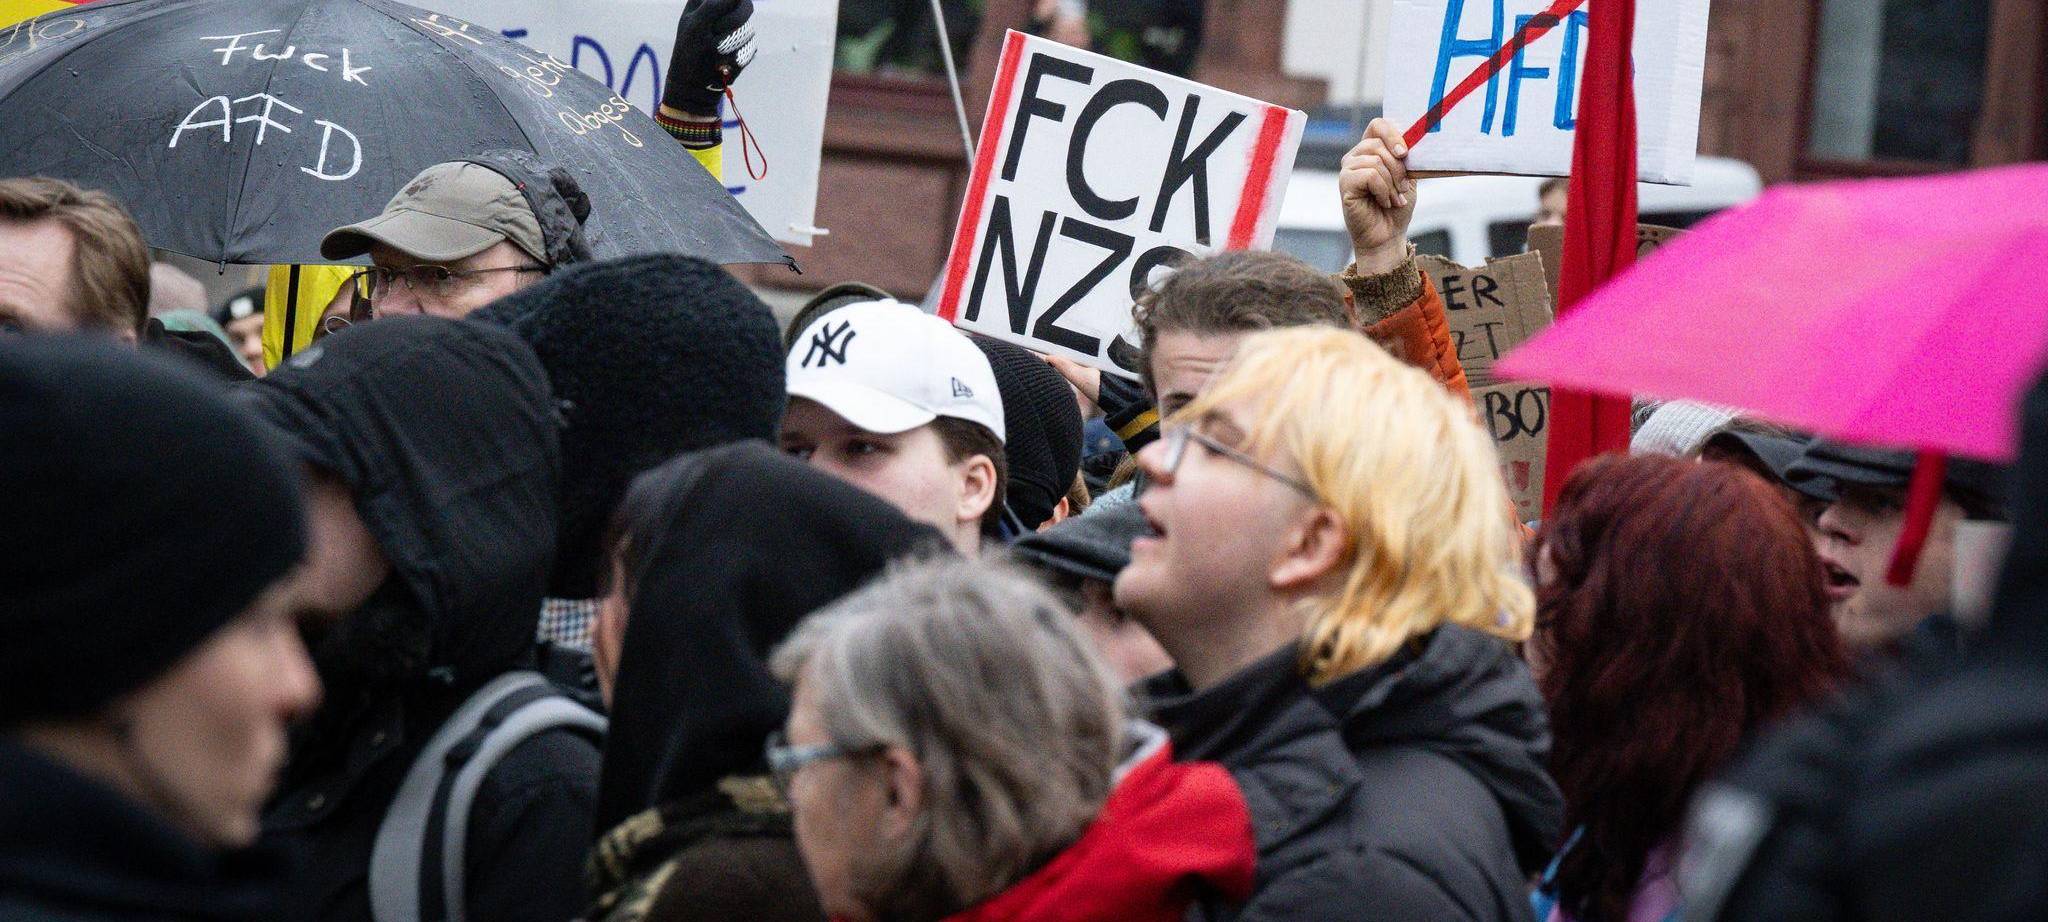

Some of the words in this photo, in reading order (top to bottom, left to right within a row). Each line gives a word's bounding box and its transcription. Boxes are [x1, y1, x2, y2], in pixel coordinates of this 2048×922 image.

[169, 92, 363, 181] AFD
[1000, 52, 1249, 247] FCK
[801, 319, 857, 369] NY
